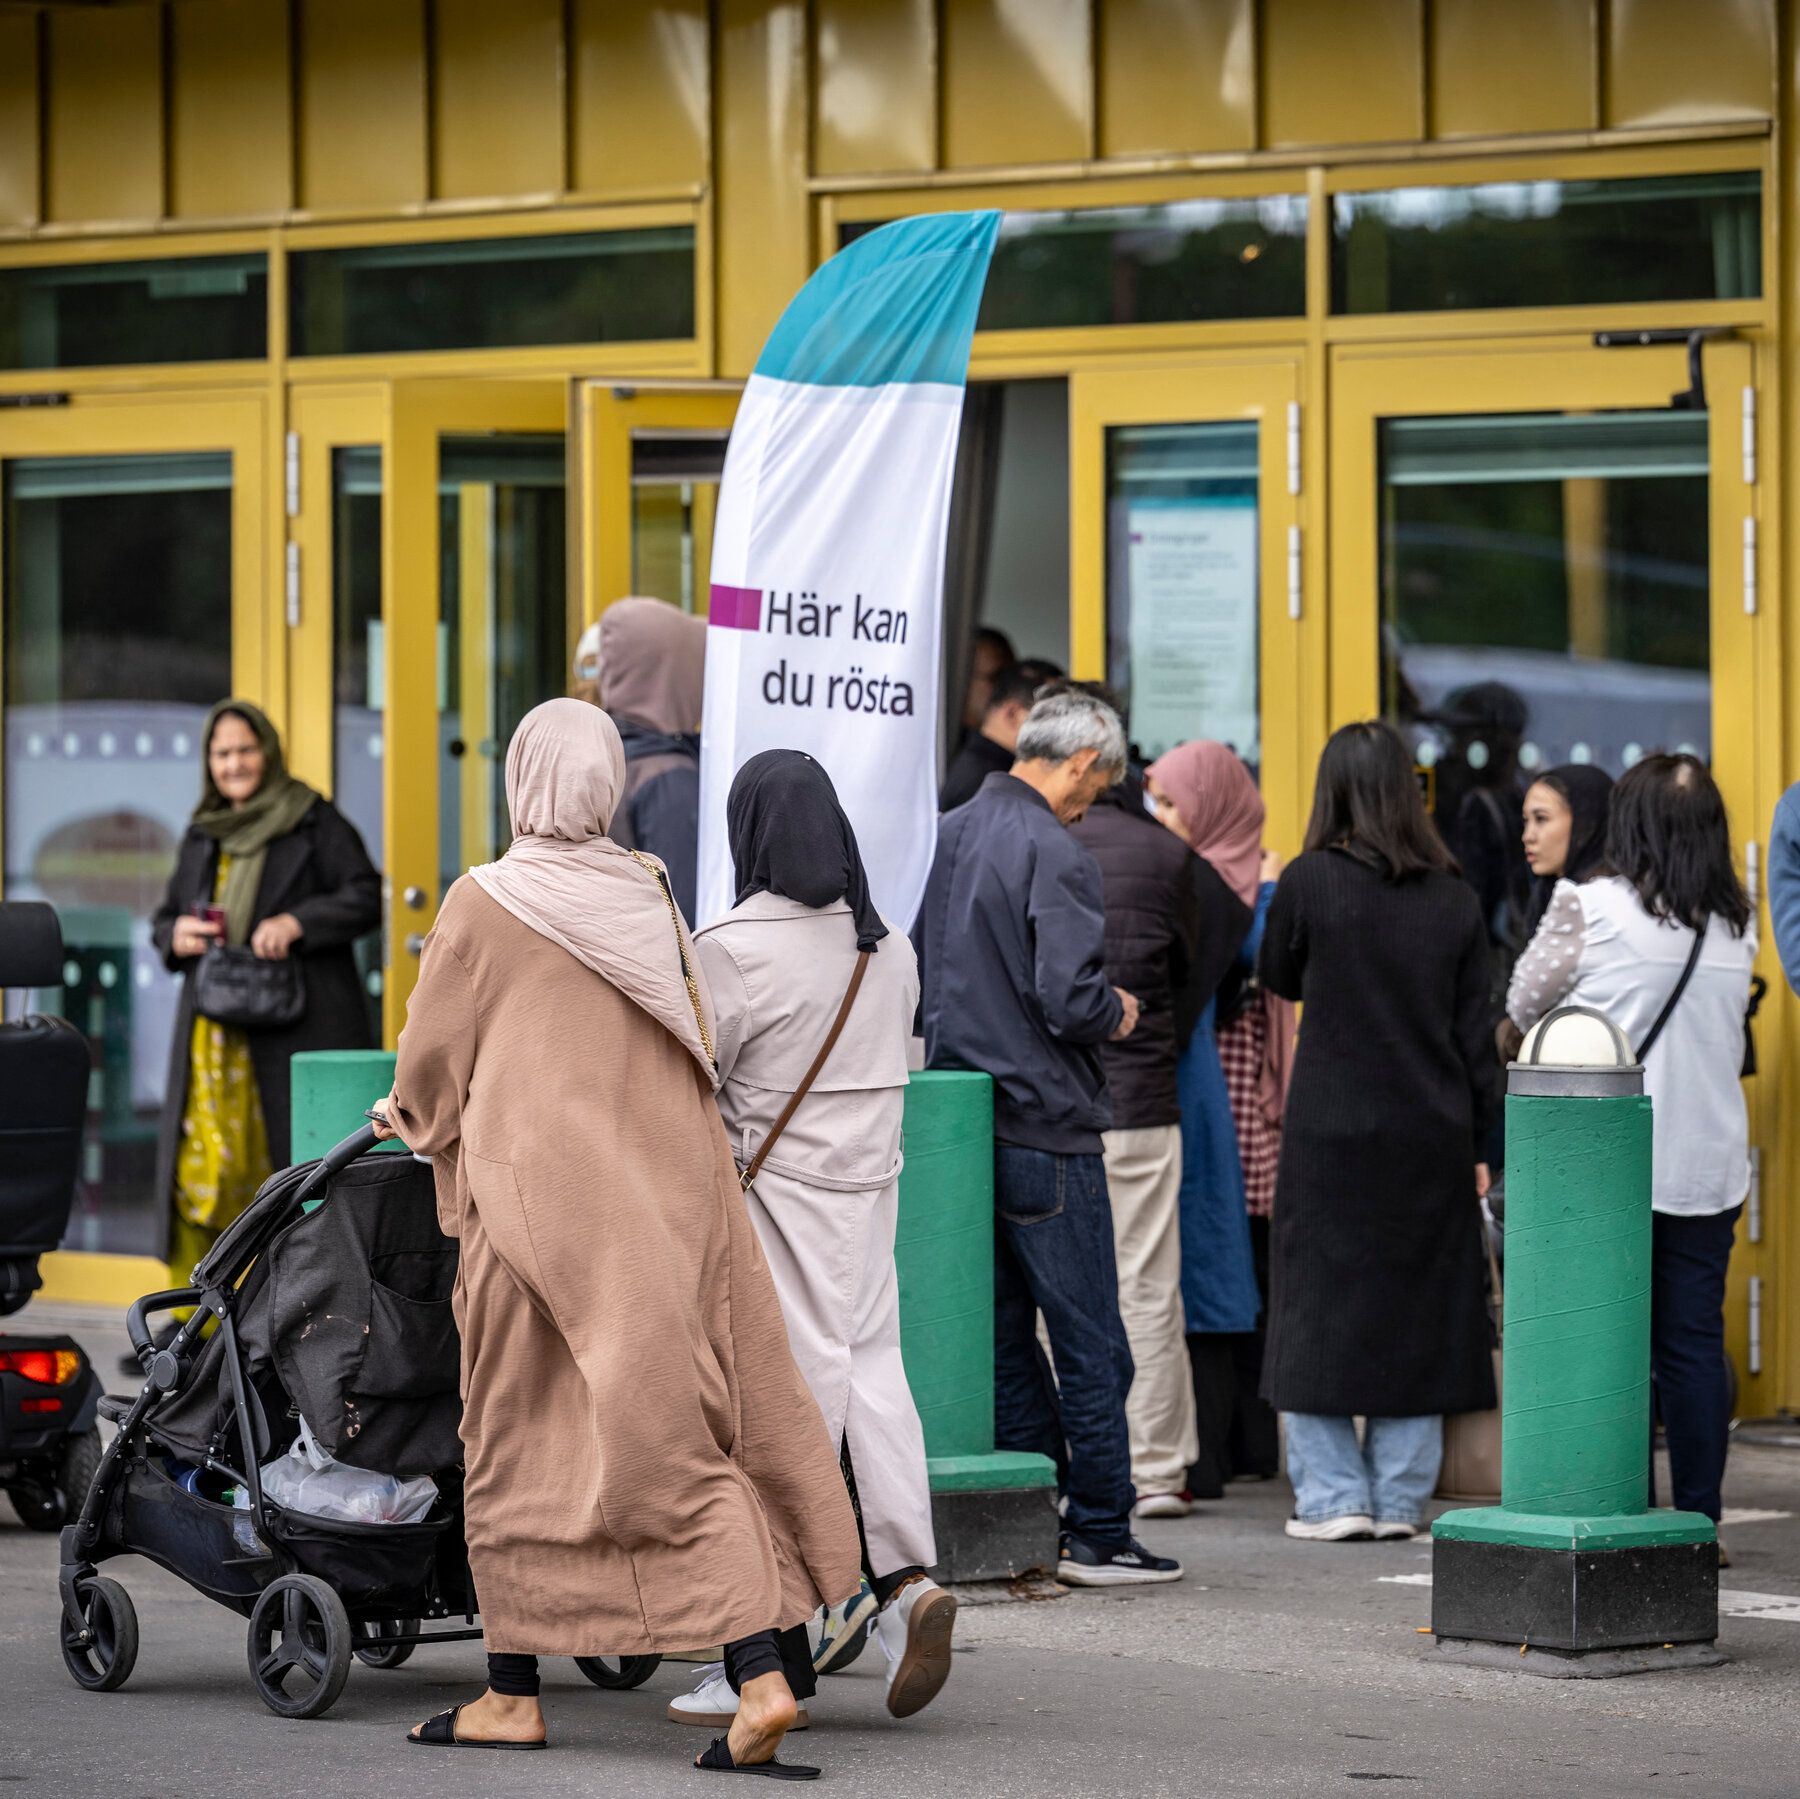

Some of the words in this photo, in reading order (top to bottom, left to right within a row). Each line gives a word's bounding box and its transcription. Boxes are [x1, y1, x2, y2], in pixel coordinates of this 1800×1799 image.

[766, 590, 842, 638] Här
[852, 593, 908, 645] kan
[762, 659, 814, 708] du
[827, 666, 915, 717] rösta
